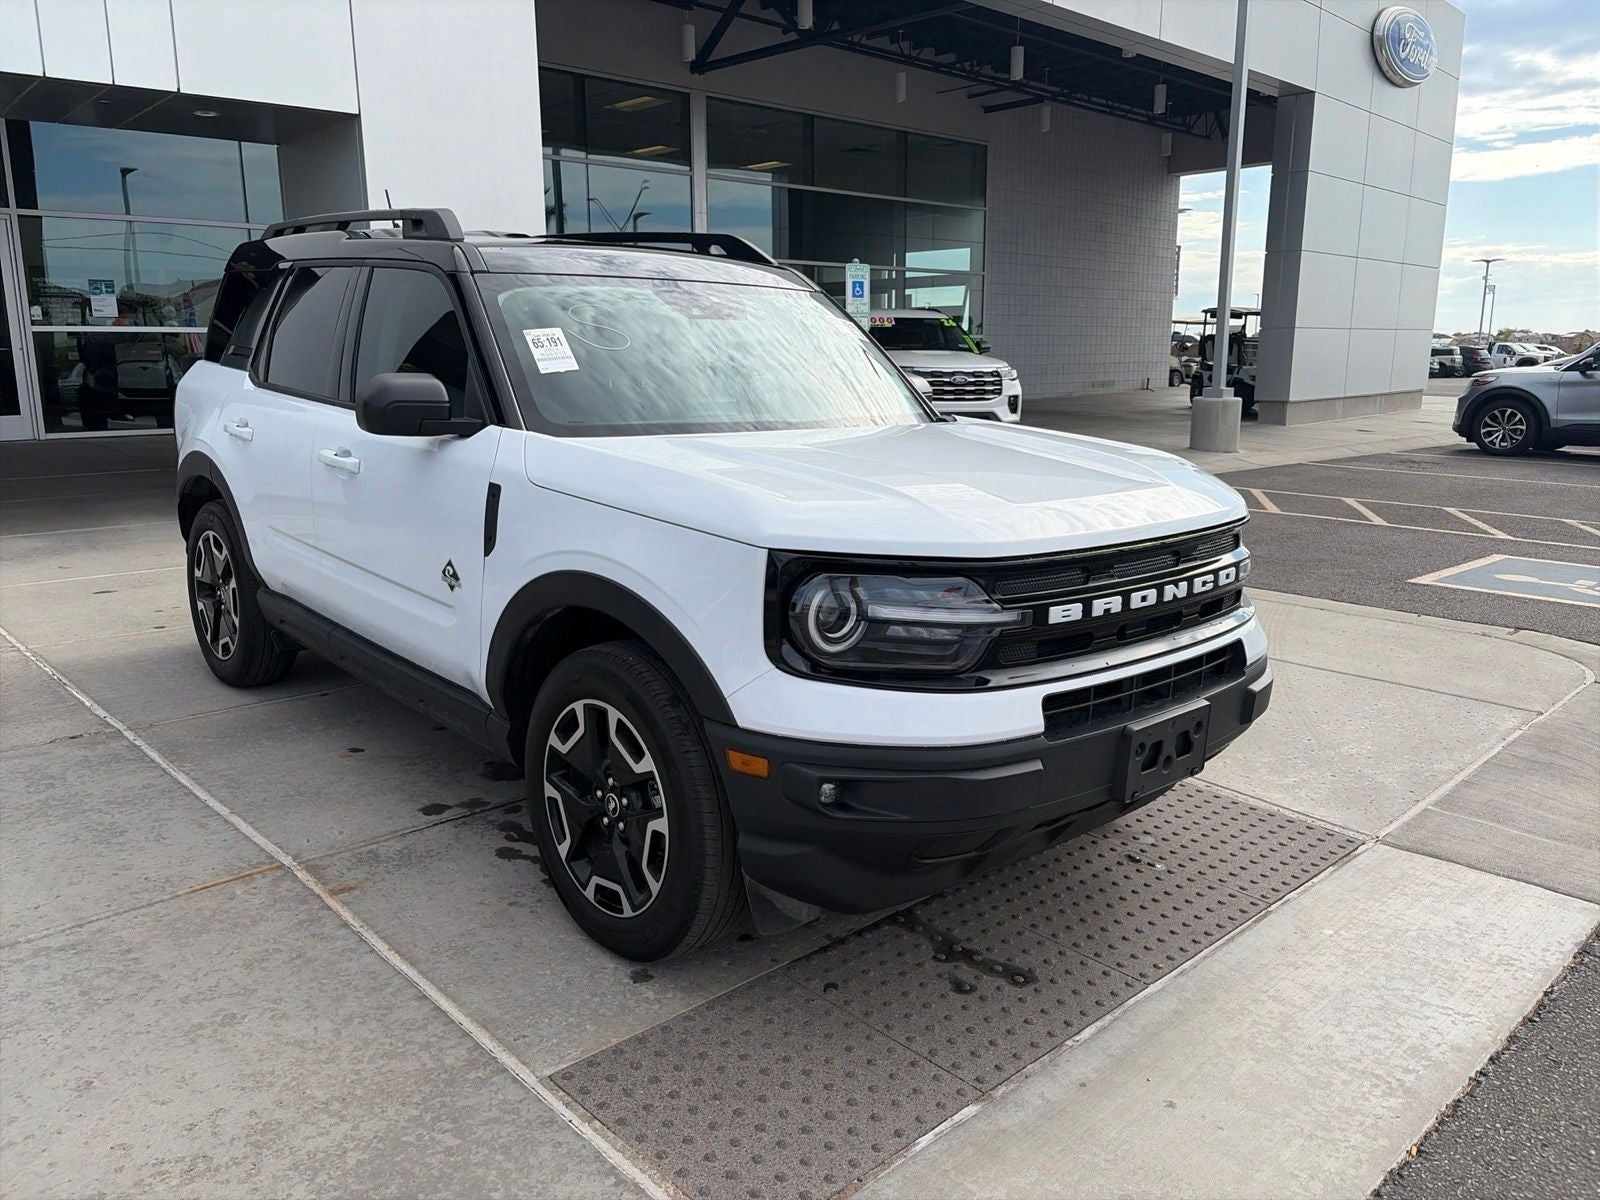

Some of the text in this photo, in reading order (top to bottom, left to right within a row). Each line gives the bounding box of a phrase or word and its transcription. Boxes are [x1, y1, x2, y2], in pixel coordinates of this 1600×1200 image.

[1399, 22, 1431, 69] Ford
[531, 337, 563, 349] 65:191
[1048, 567, 1237, 625] BRONCO
